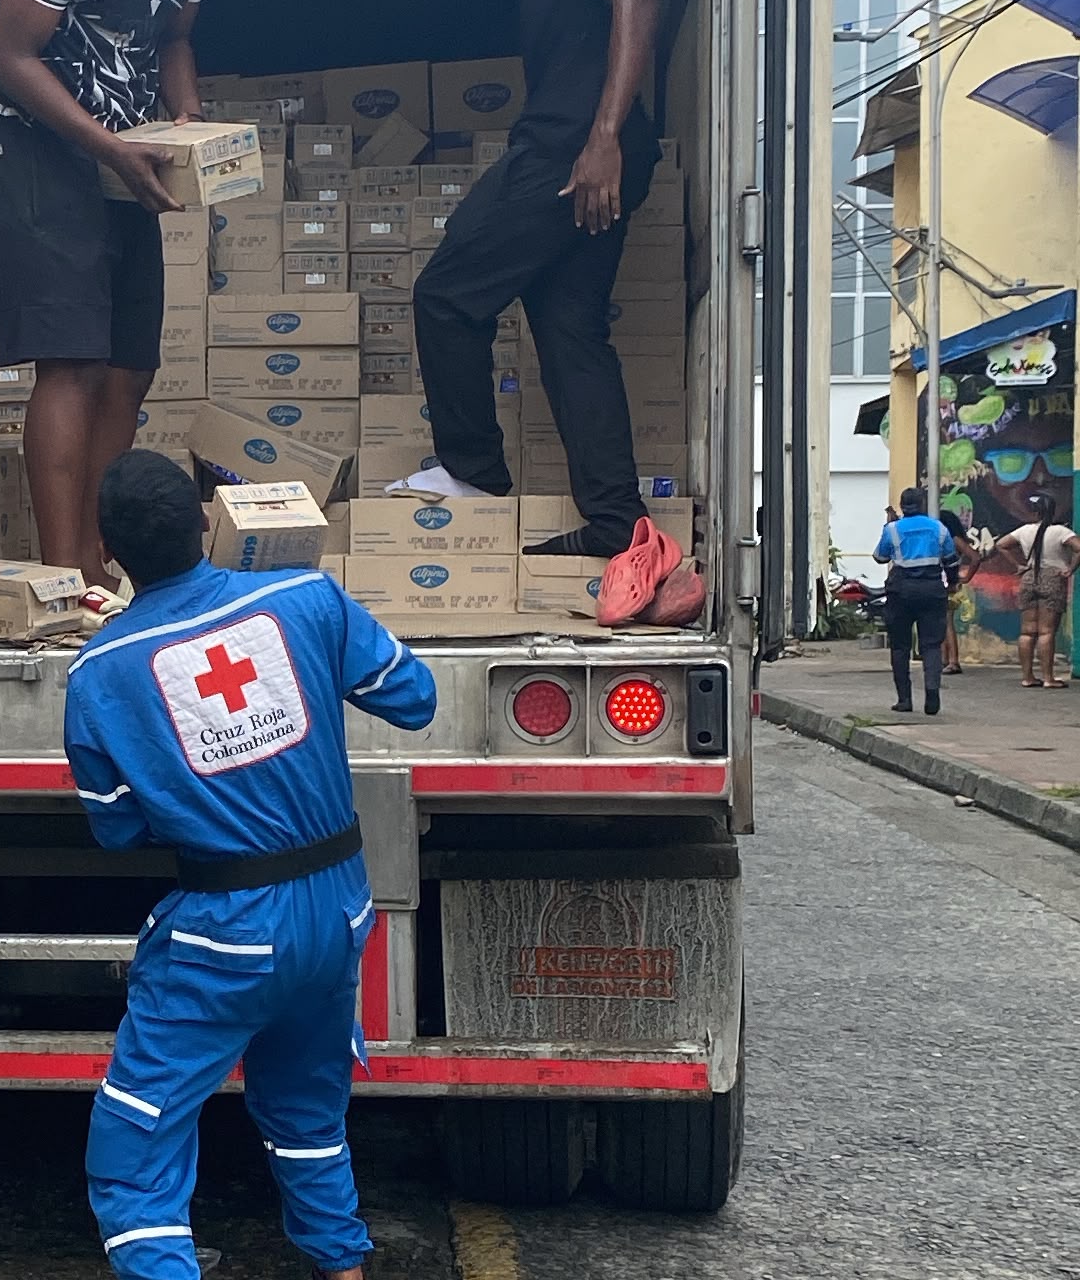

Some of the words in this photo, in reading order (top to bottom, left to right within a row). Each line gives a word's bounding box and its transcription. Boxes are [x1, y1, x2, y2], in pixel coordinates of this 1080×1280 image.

[416, 508, 450, 521] Alpina
[412, 568, 447, 580] Alpina
[200, 724, 246, 746] Cruz
[248, 707, 287, 732] Roja
[201, 722, 297, 763] Colombiana
